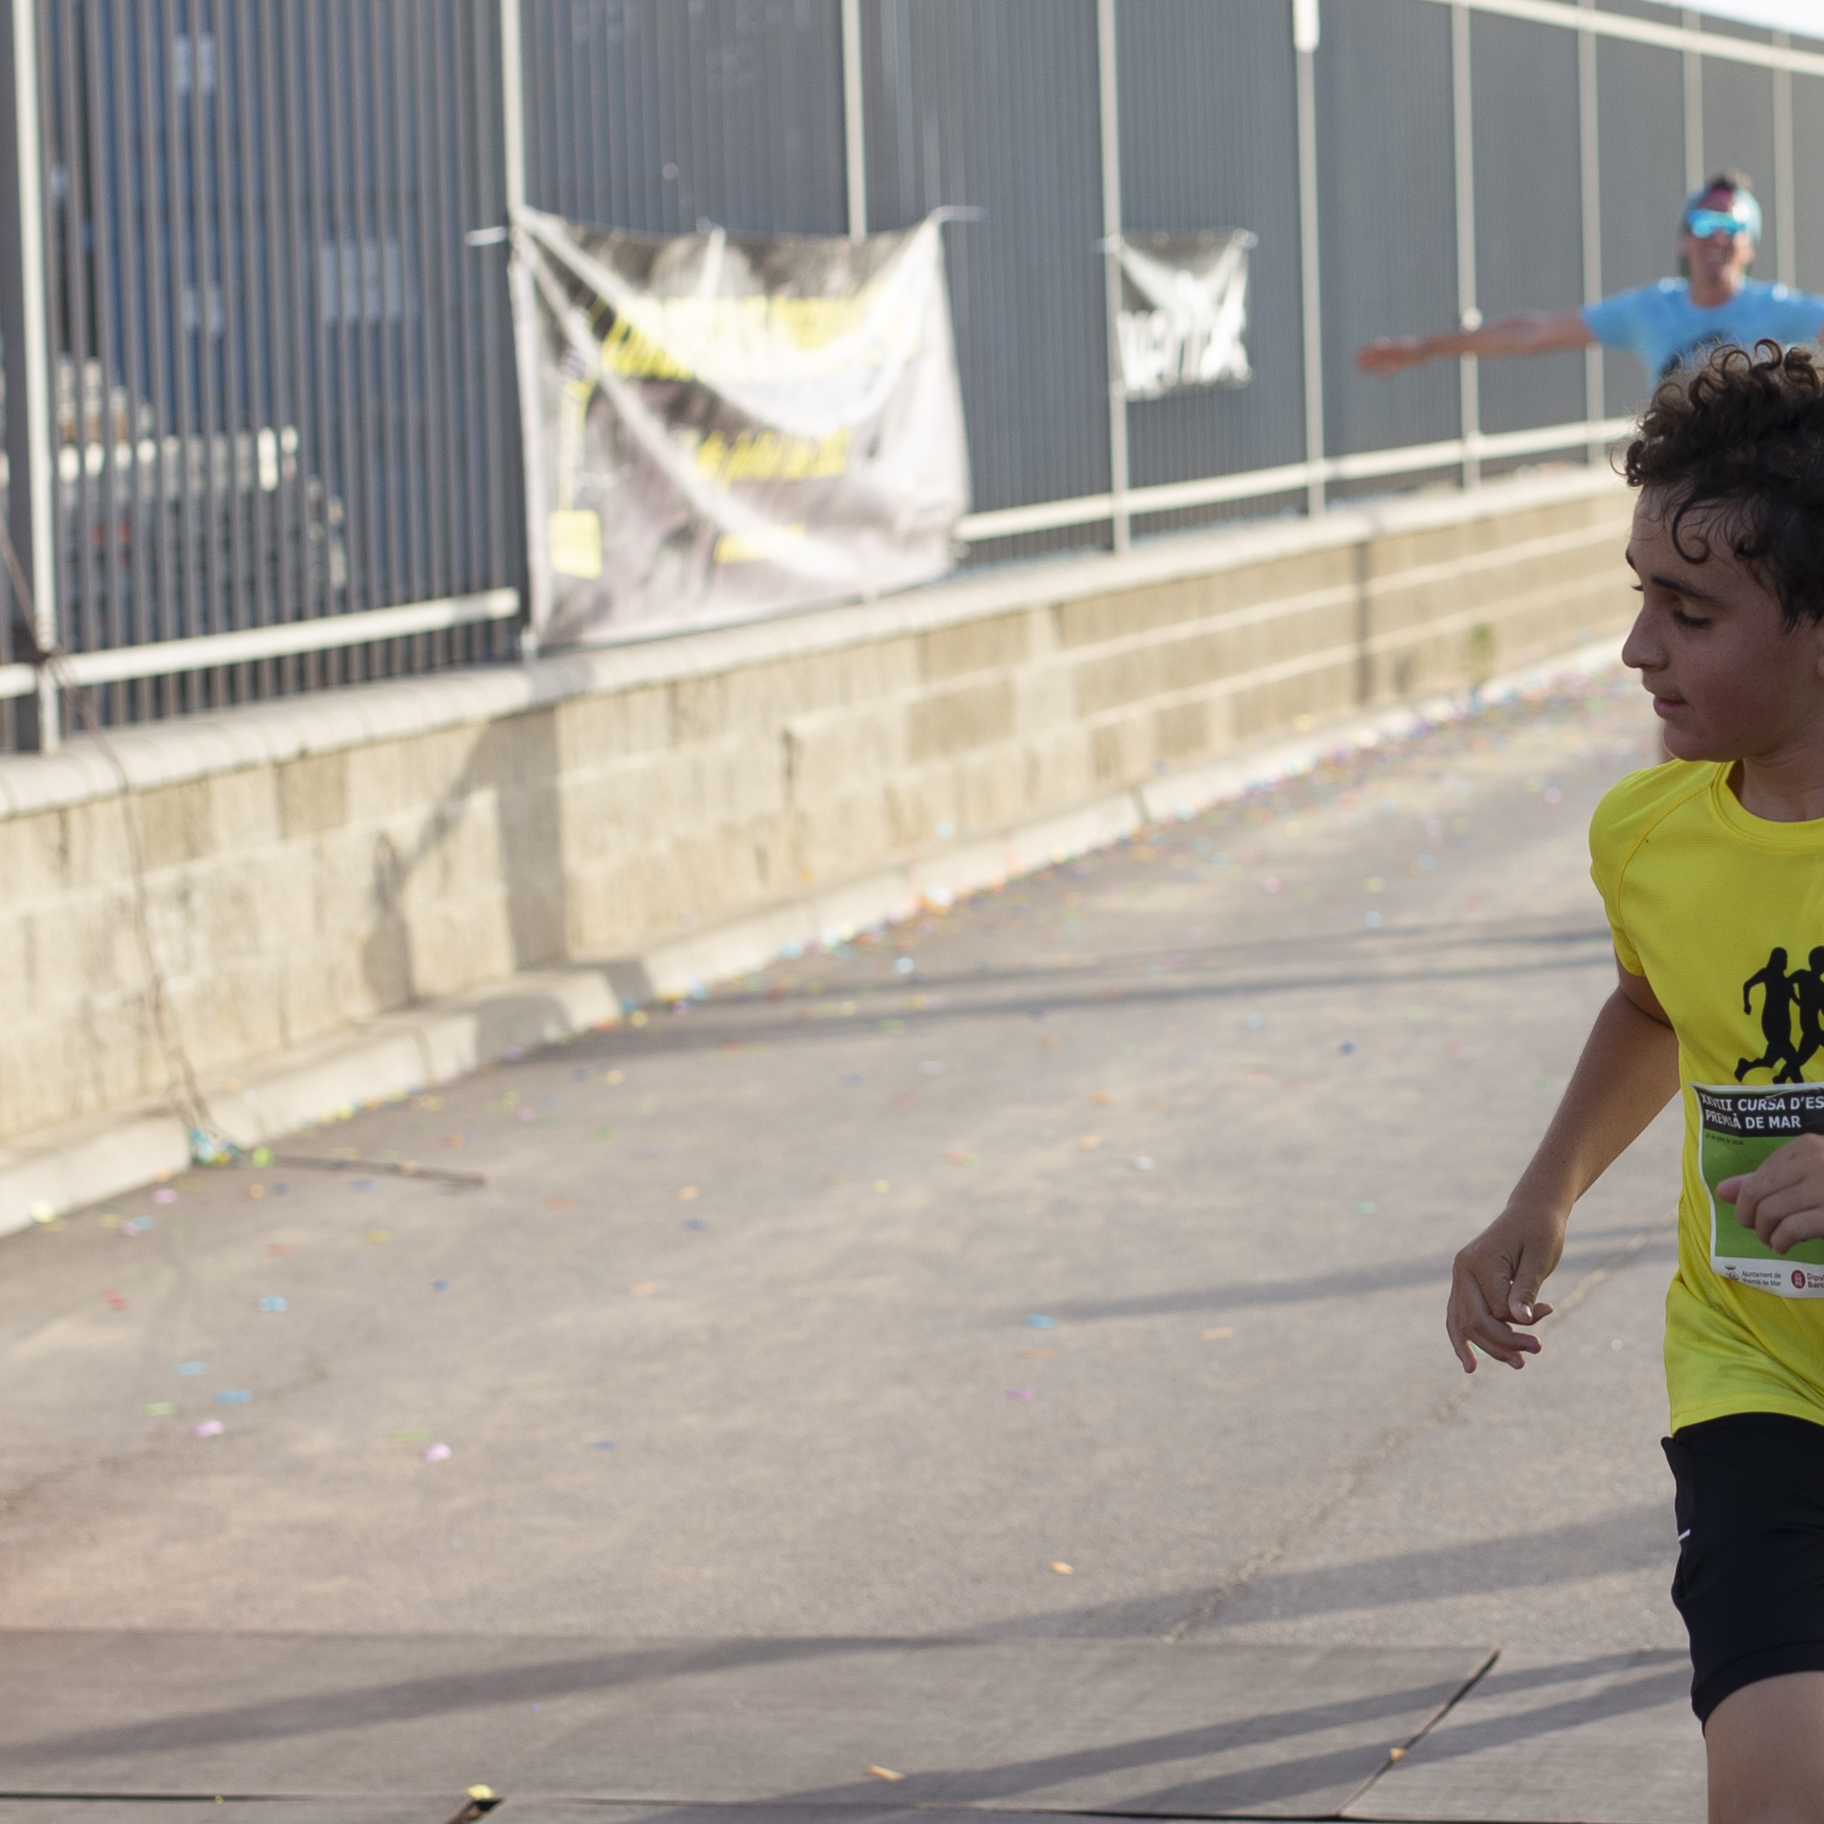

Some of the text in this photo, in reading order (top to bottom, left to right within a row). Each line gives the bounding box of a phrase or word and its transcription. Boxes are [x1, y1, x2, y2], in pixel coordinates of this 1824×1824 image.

[1738, 1097, 1786, 1112] CURSA
[1705, 1108, 1802, 1130] PREMIÀ DE MAR
